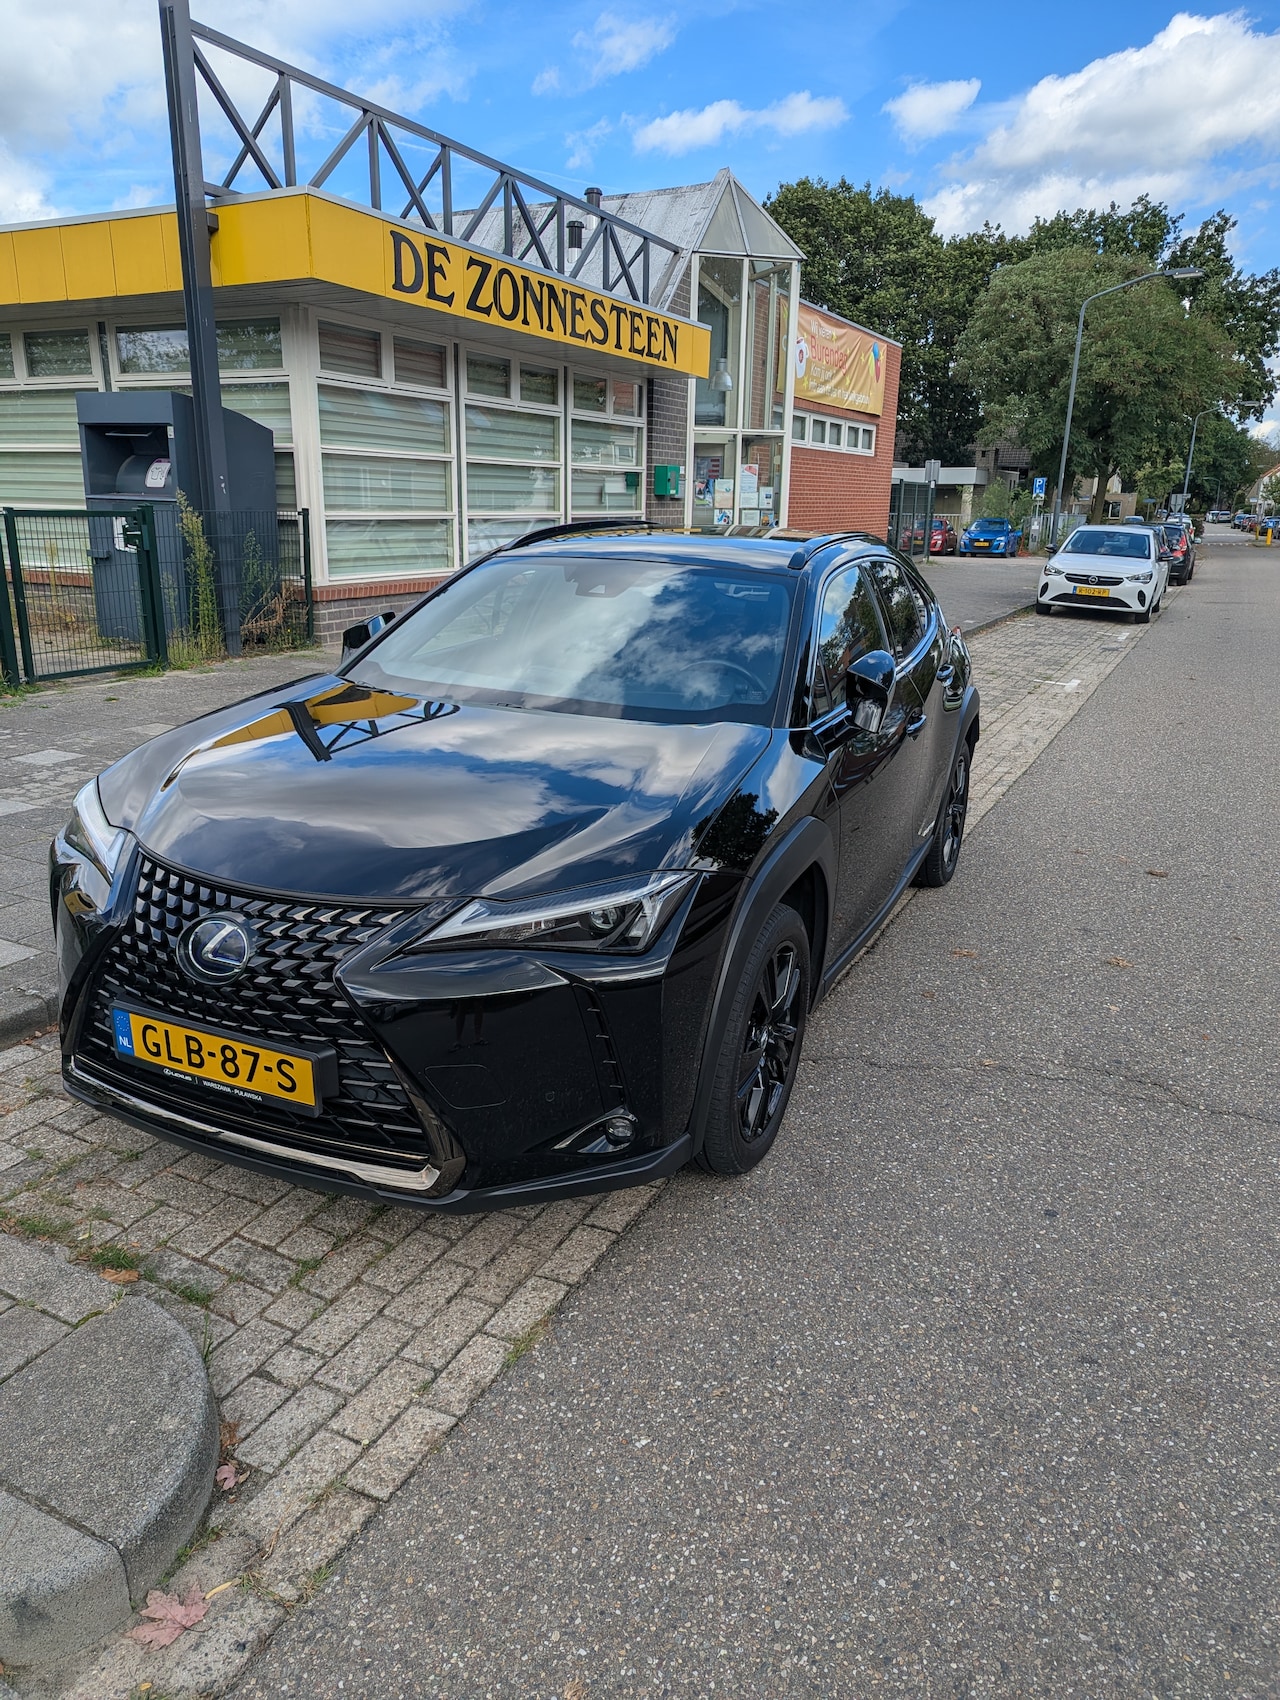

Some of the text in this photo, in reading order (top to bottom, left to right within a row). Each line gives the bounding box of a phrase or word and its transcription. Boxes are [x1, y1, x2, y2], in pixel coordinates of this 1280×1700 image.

[389, 230, 679, 365] DE ZONNESTEEN
[118, 1035, 132, 1049] NL
[141, 1024, 297, 1093] GLB-87-S
[171, 1071, 192, 1081] LEXUS
[202, 1080, 231, 1093] WARSZAWA
